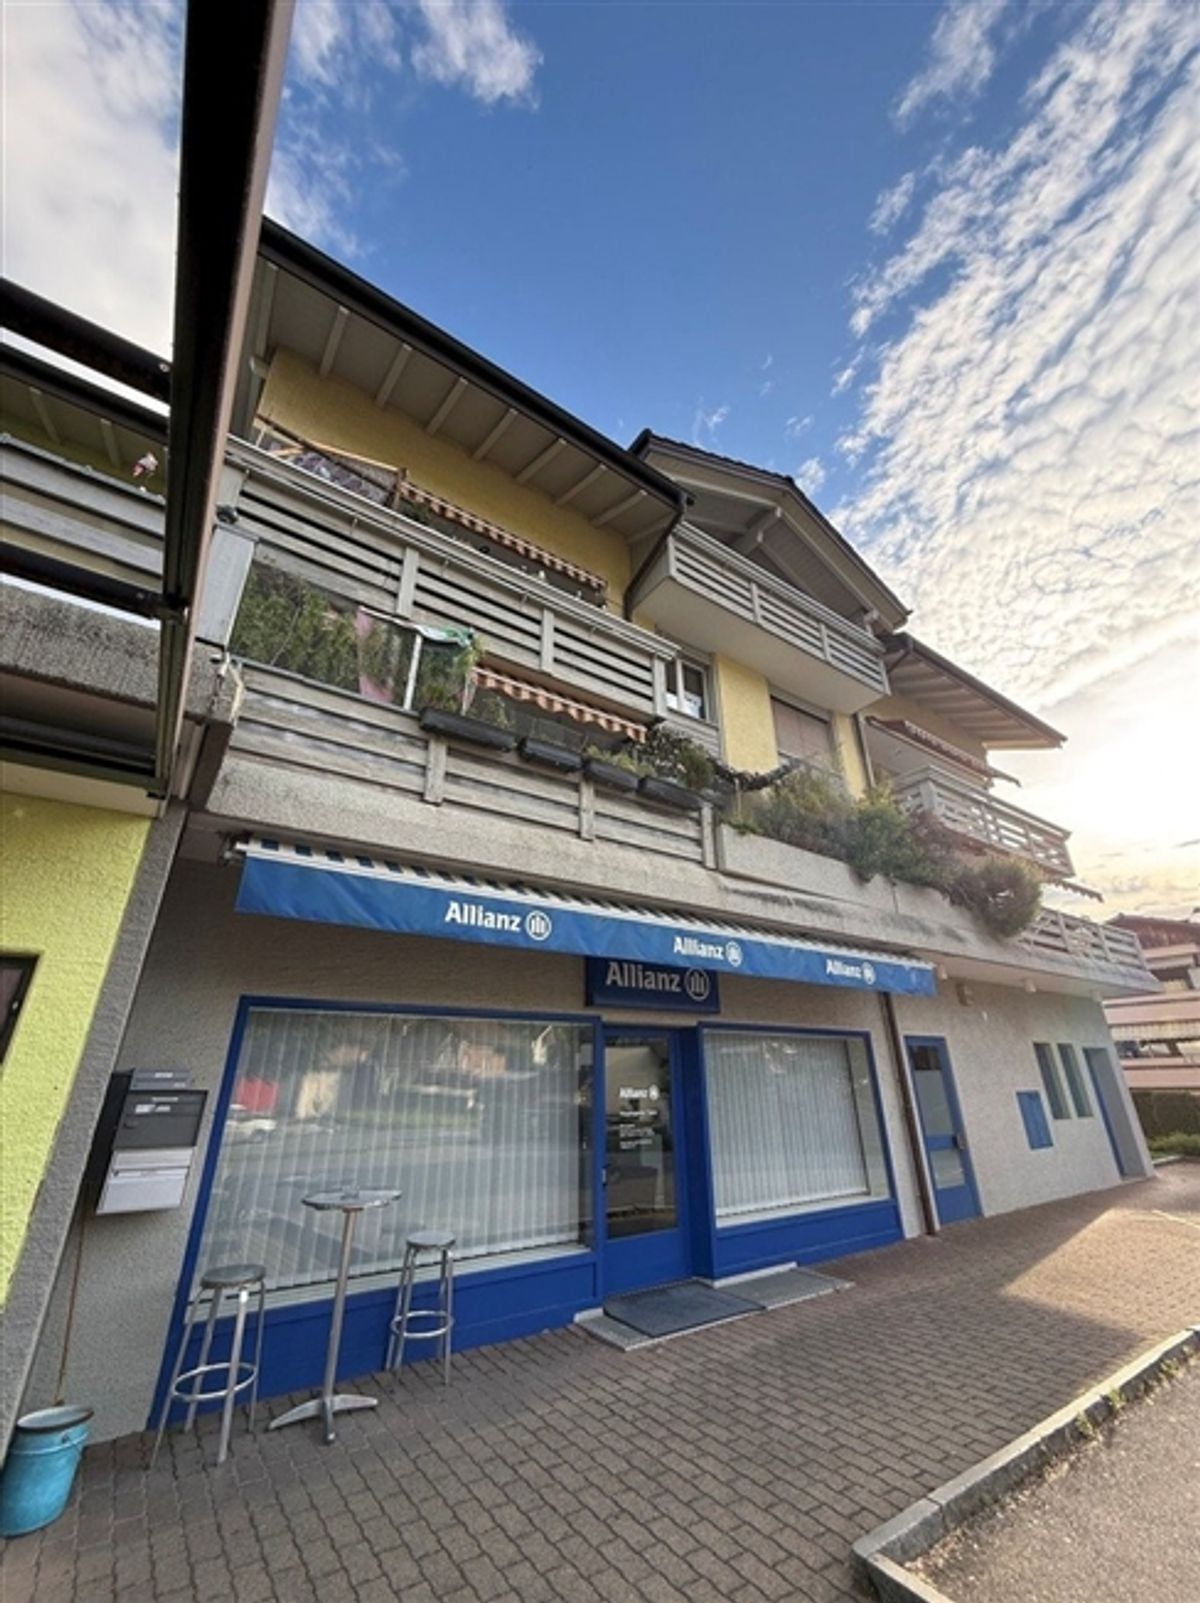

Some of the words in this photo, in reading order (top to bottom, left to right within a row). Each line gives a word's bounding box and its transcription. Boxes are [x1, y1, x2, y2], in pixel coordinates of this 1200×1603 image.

[445, 900, 521, 932] Allianz
[674, 937, 724, 959] Allianz
[606, 962, 681, 992] Allianz
[826, 959, 863, 979] Allianz
